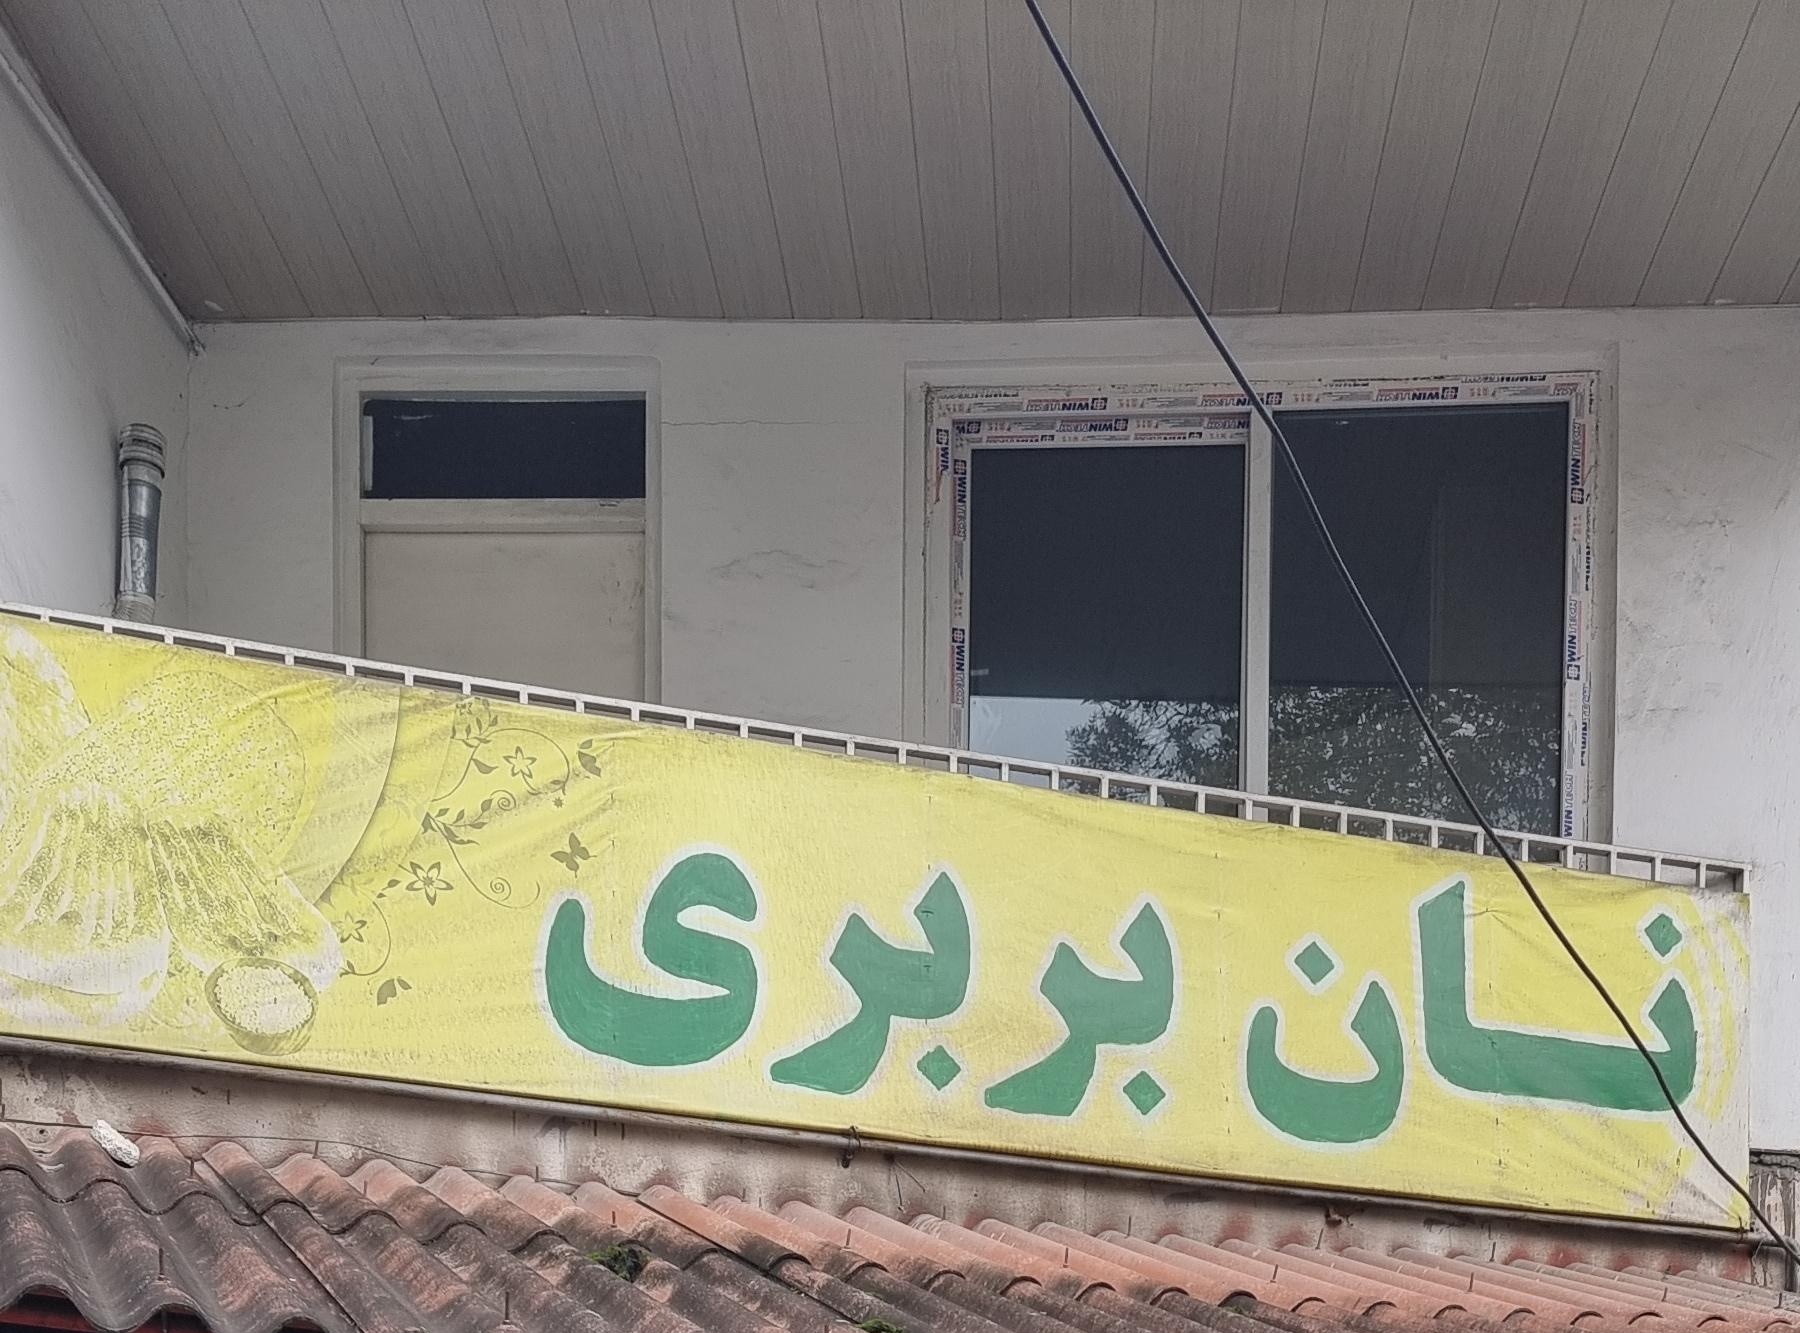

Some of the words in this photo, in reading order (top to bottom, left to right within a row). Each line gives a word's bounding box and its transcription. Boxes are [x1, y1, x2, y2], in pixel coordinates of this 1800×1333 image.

[1567, 598, 1578, 663] WINTECH
[1563, 773, 1574, 838] WINTECH
[543, 850, 1176, 1119] بربری
[1243, 878, 1698, 1146] نان
